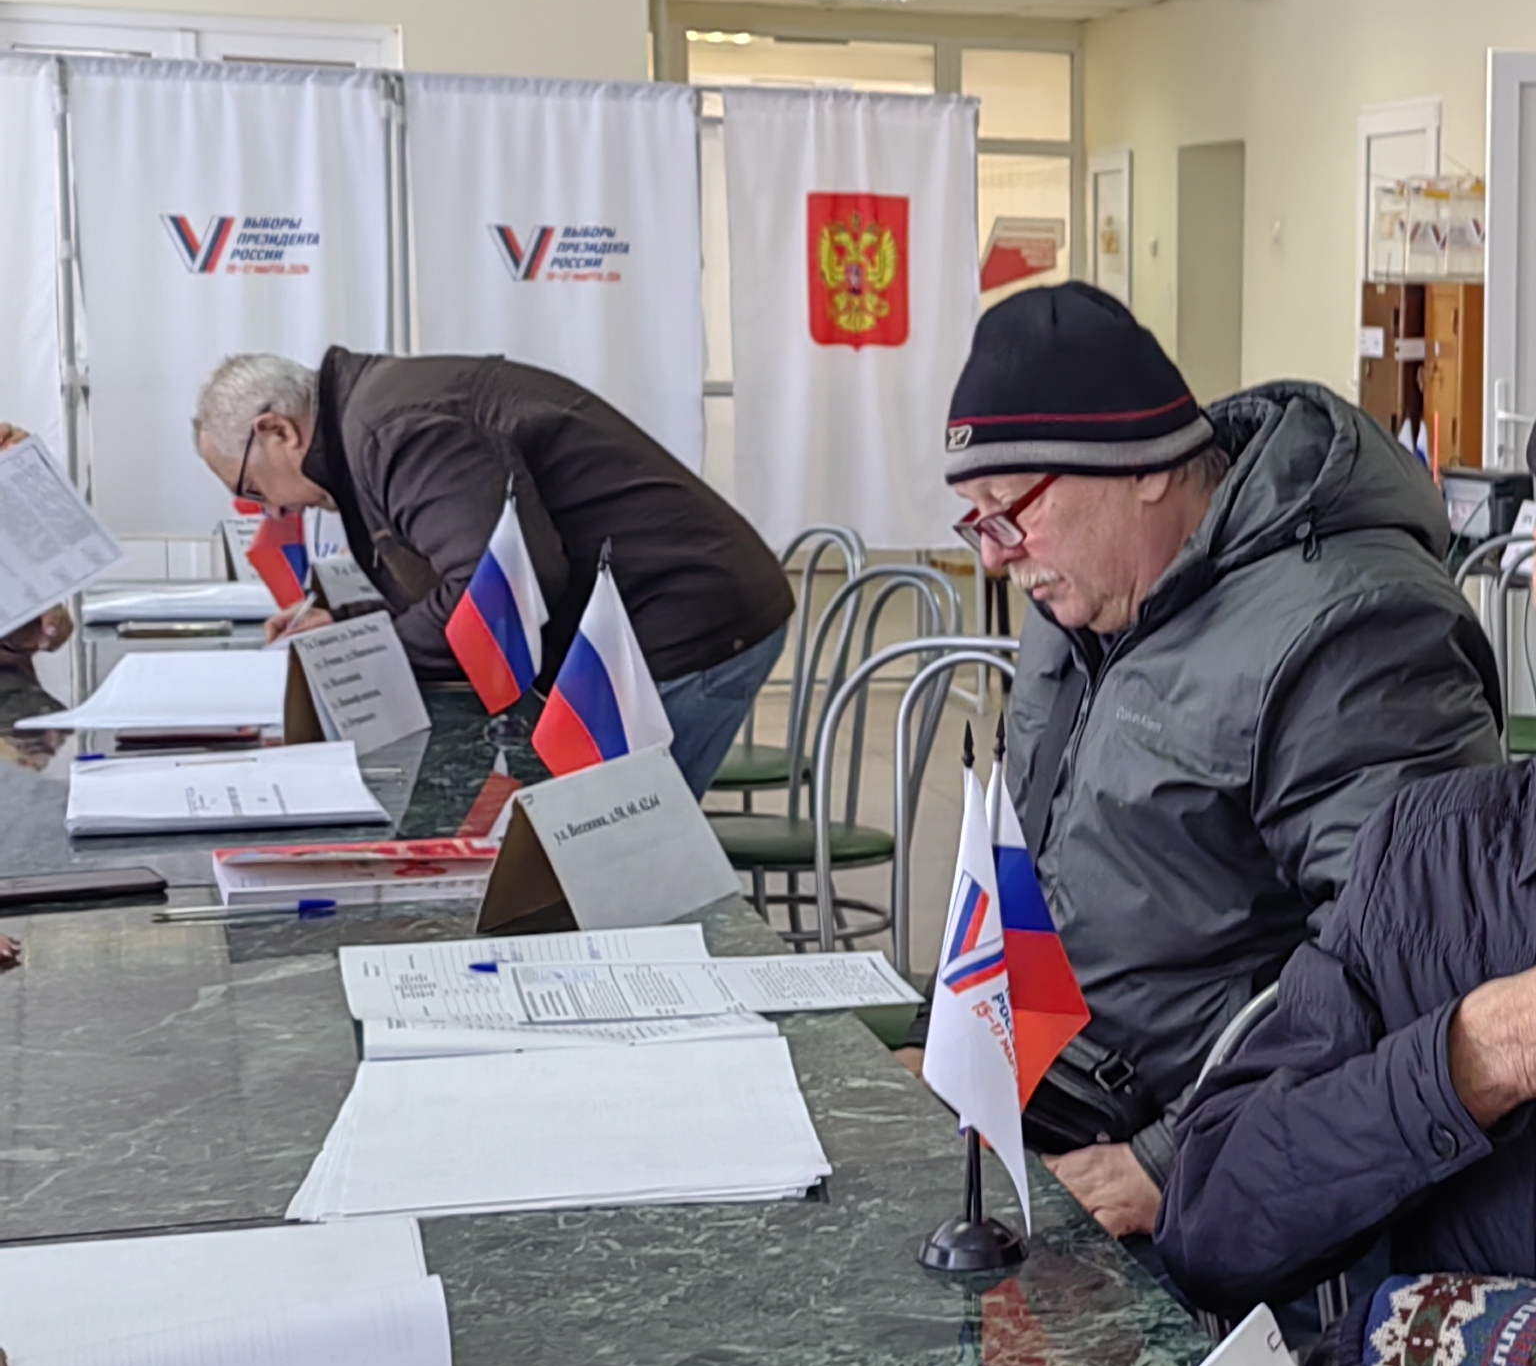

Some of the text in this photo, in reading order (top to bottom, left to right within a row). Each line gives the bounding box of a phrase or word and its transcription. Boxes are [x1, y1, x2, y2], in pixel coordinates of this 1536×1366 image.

[243, 216, 302, 229] ВЫБОРЫ
[562, 226, 616, 239] ВЫБОРЫ
[236, 232, 320, 247] ПРЕЗИДЕНТА
[230, 248, 284, 261] РОССИИ
[556, 241, 631, 255] ПРЕЗИДЕНТА
[550, 256, 603, 270] РОССИИ
